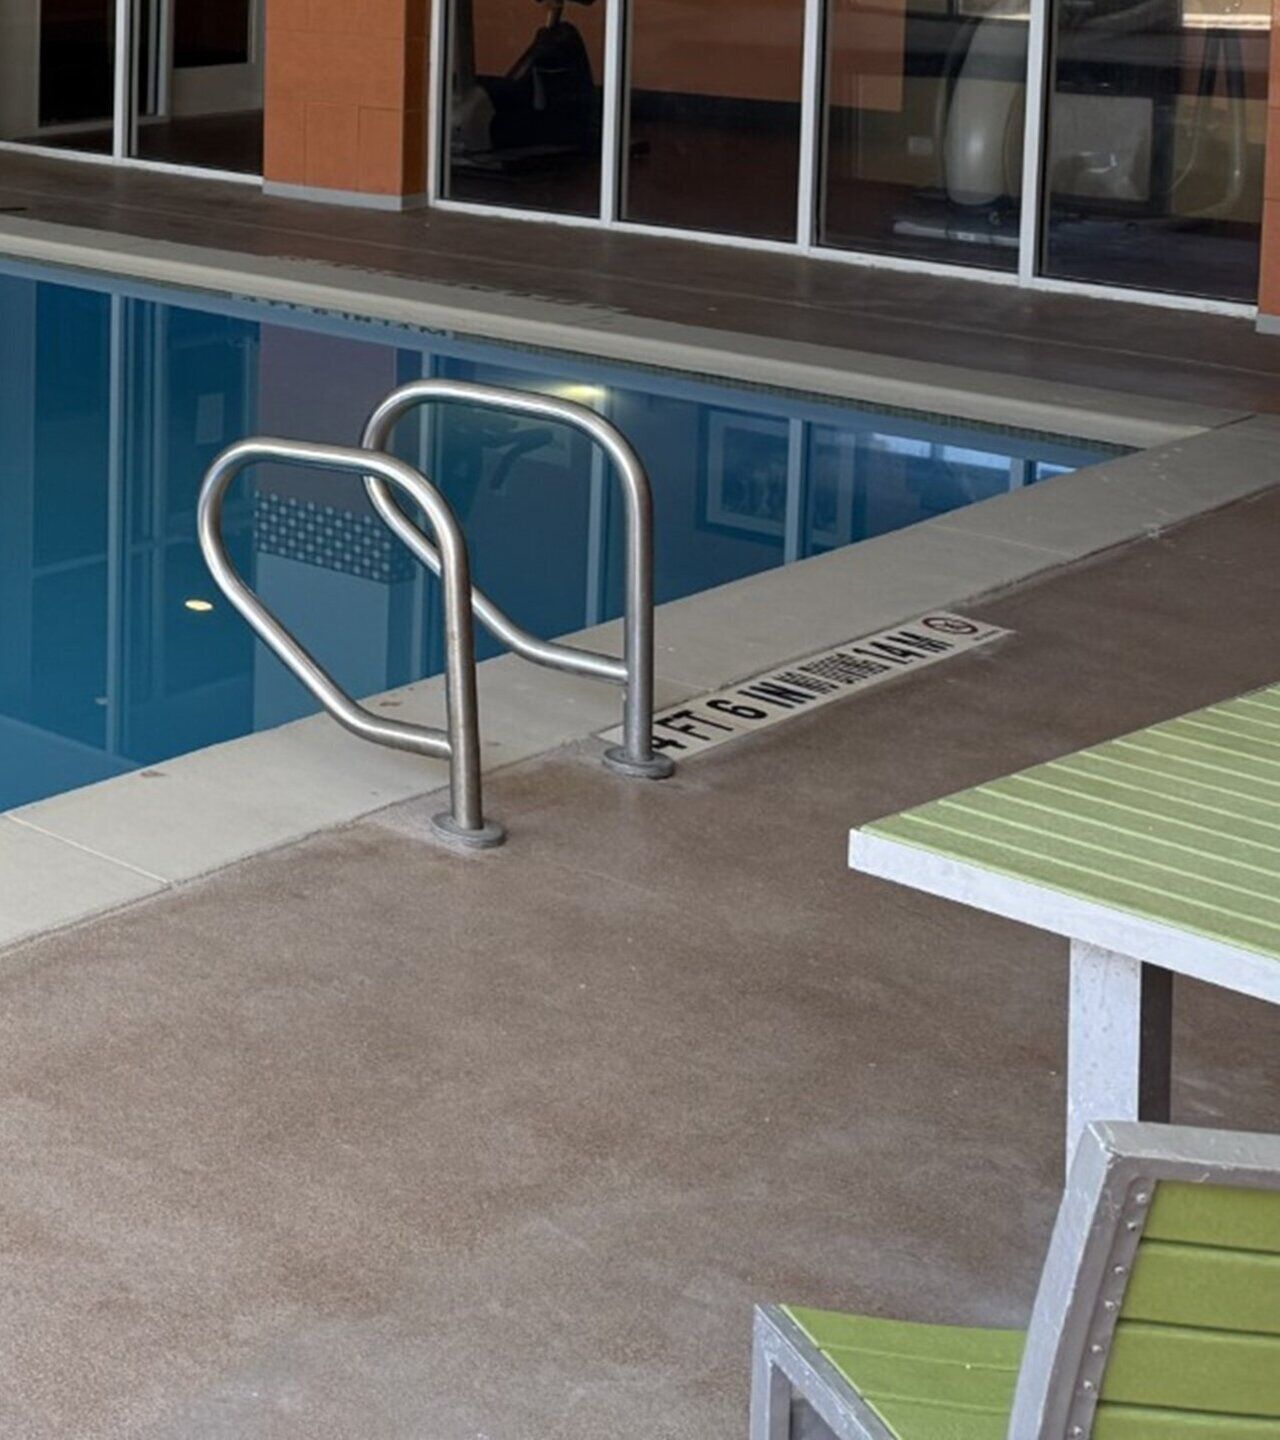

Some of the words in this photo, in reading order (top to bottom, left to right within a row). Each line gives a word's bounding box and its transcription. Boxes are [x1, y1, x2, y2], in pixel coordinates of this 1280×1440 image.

[653, 709, 733, 741] FT
[706, 699, 768, 720] 6
[737, 680, 817, 709] IN
